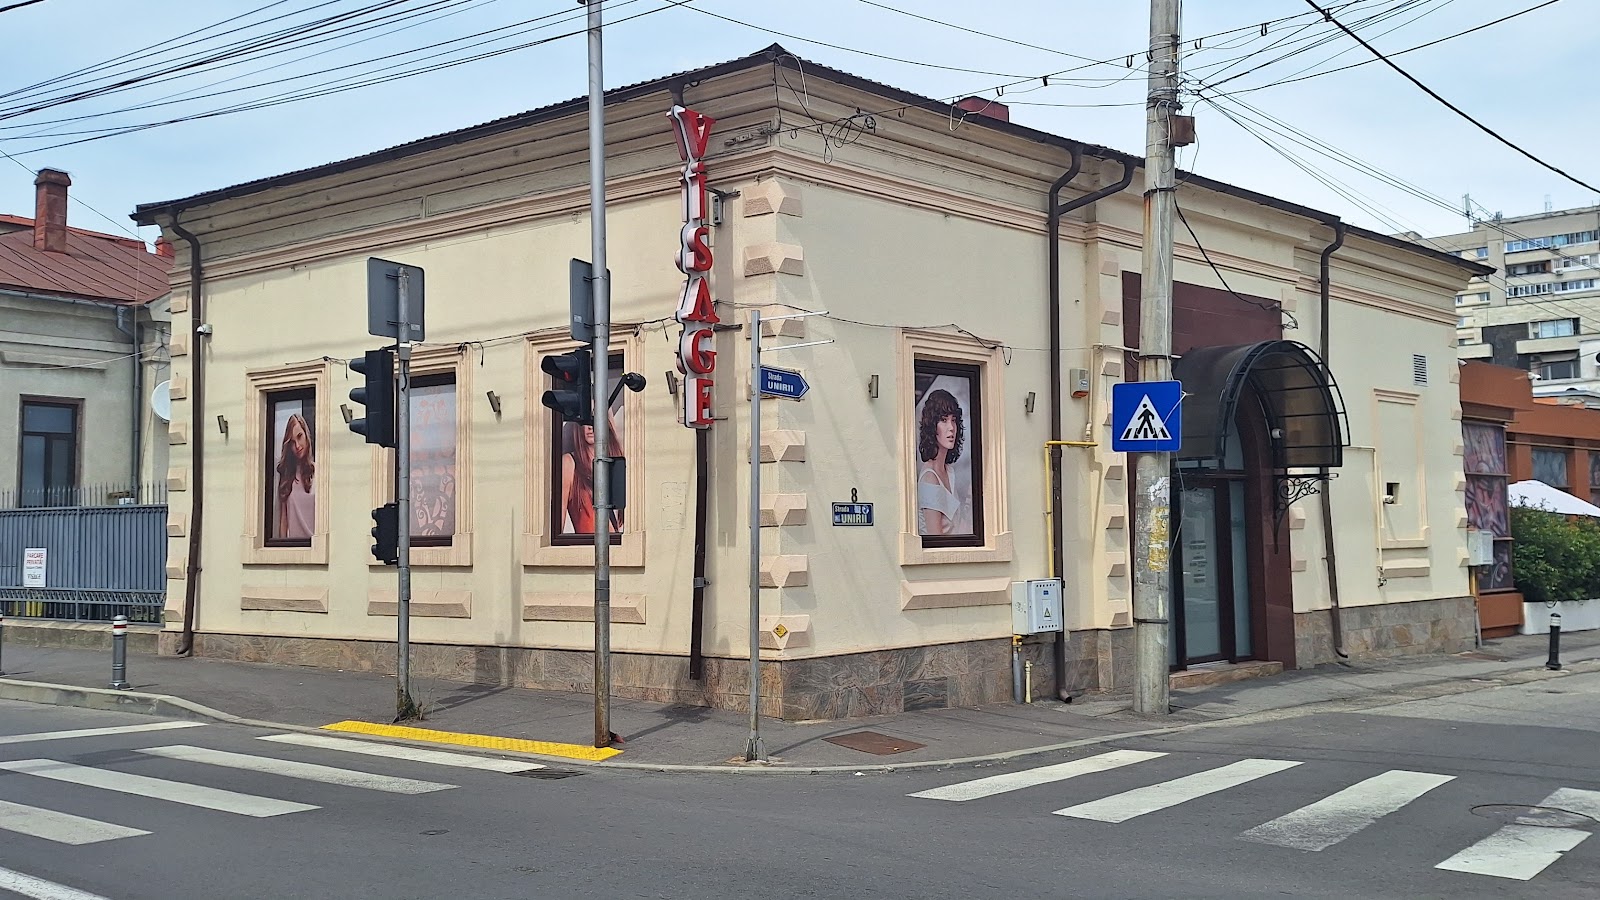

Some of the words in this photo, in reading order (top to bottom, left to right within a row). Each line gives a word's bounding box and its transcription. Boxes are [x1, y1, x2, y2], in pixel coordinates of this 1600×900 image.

[768, 372, 782, 381] Strada
[768, 382, 794, 392] UNIRII
[851, 488, 858, 503] 8
[841, 514, 868, 523] UNIRII
